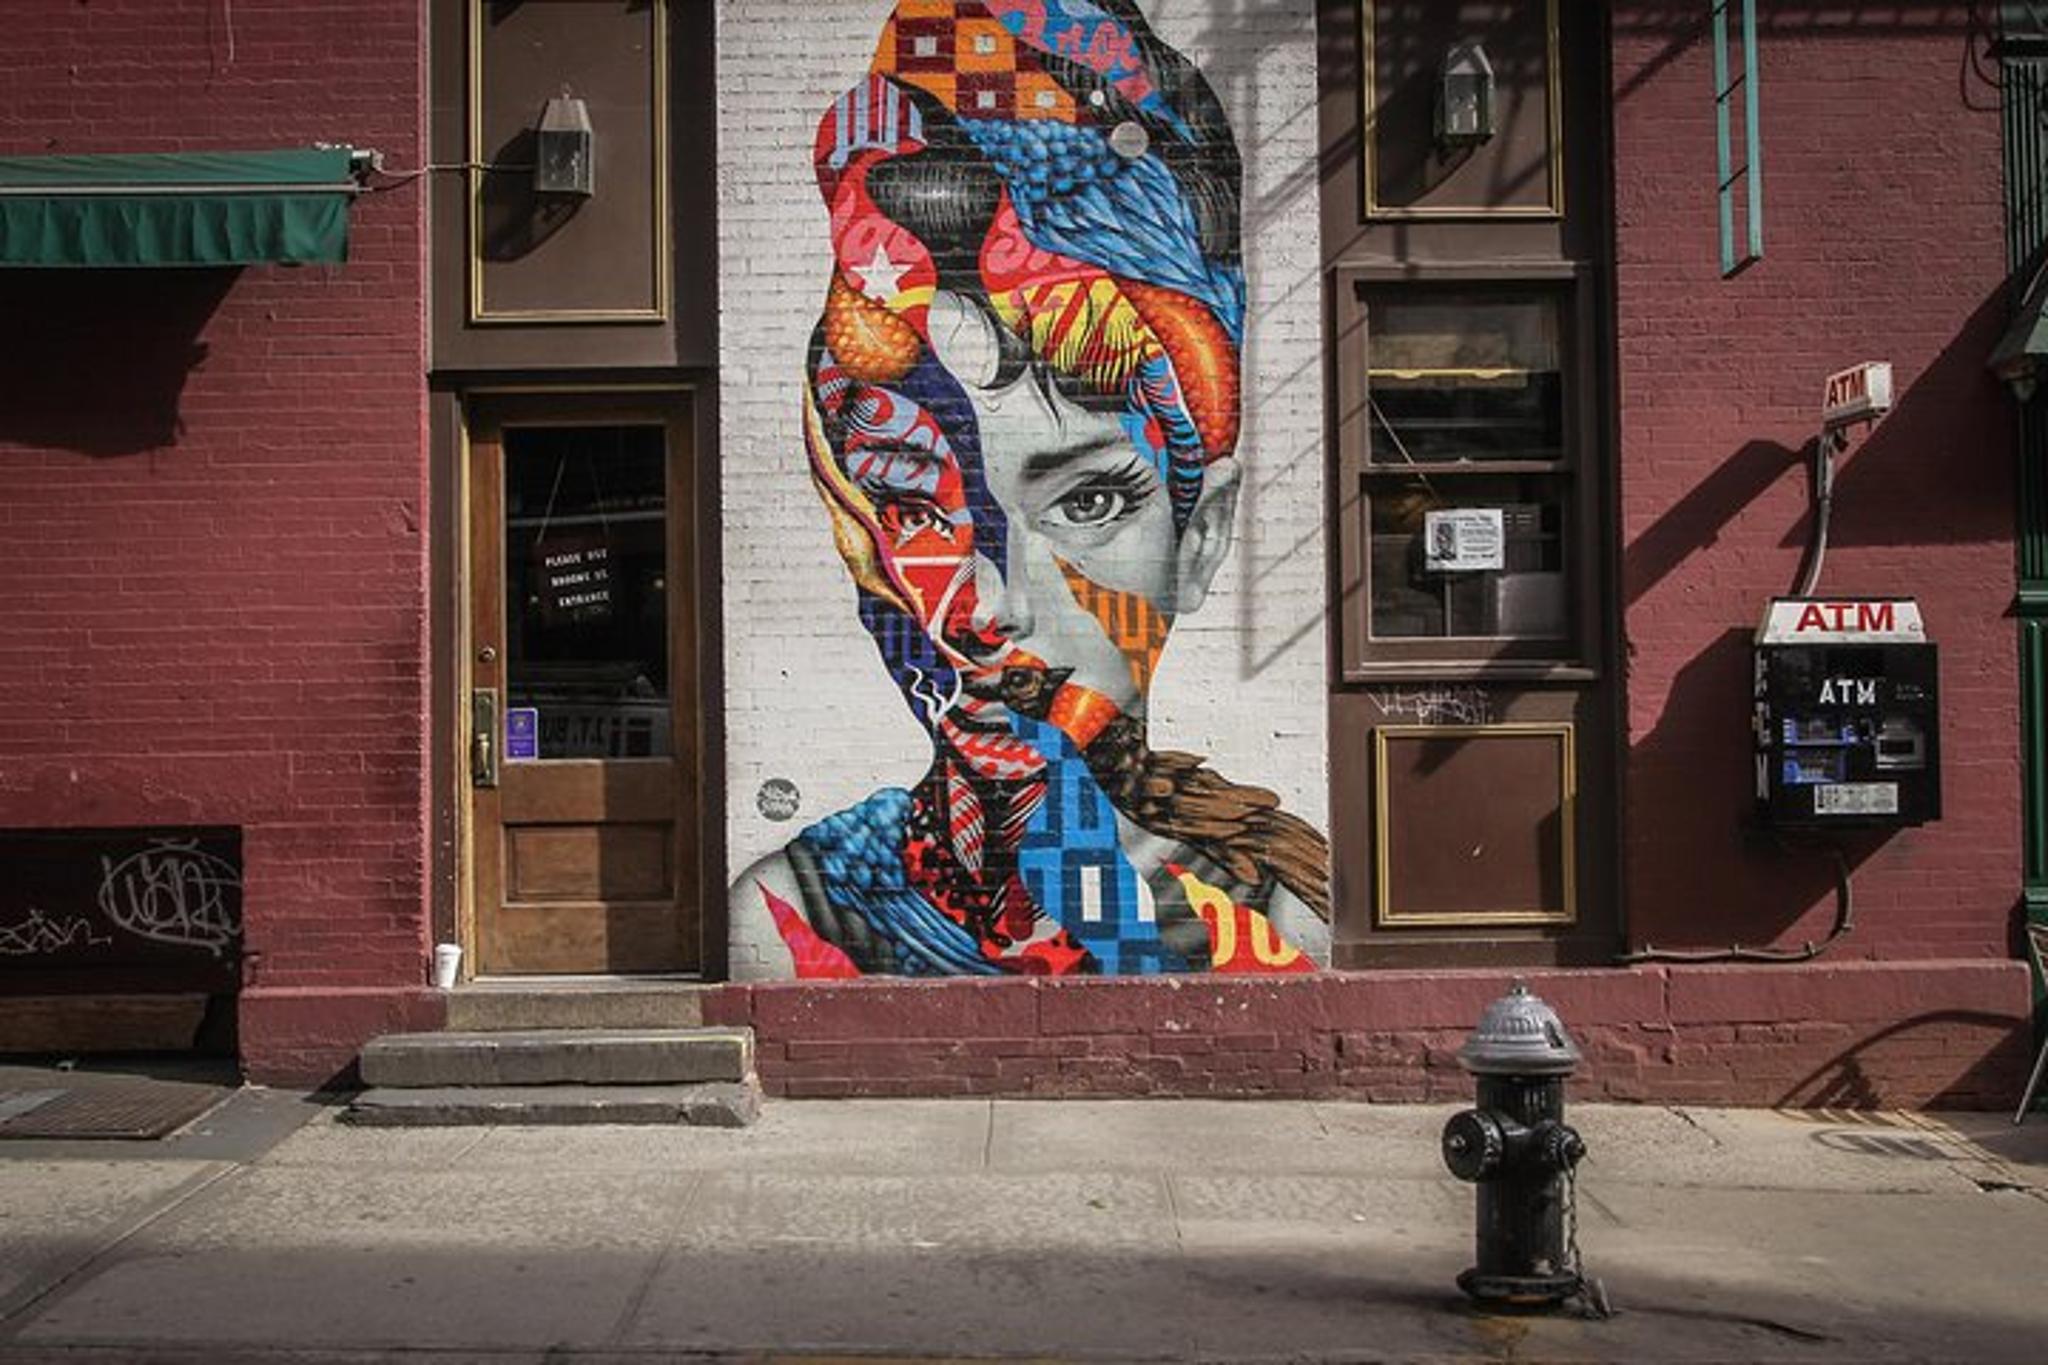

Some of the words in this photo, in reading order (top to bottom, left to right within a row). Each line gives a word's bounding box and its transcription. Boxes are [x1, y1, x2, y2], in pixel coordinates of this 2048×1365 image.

[1827, 370, 1865, 407] ATM
[1796, 603, 1894, 631] ATM
[1819, 679, 1875, 704] ATM
